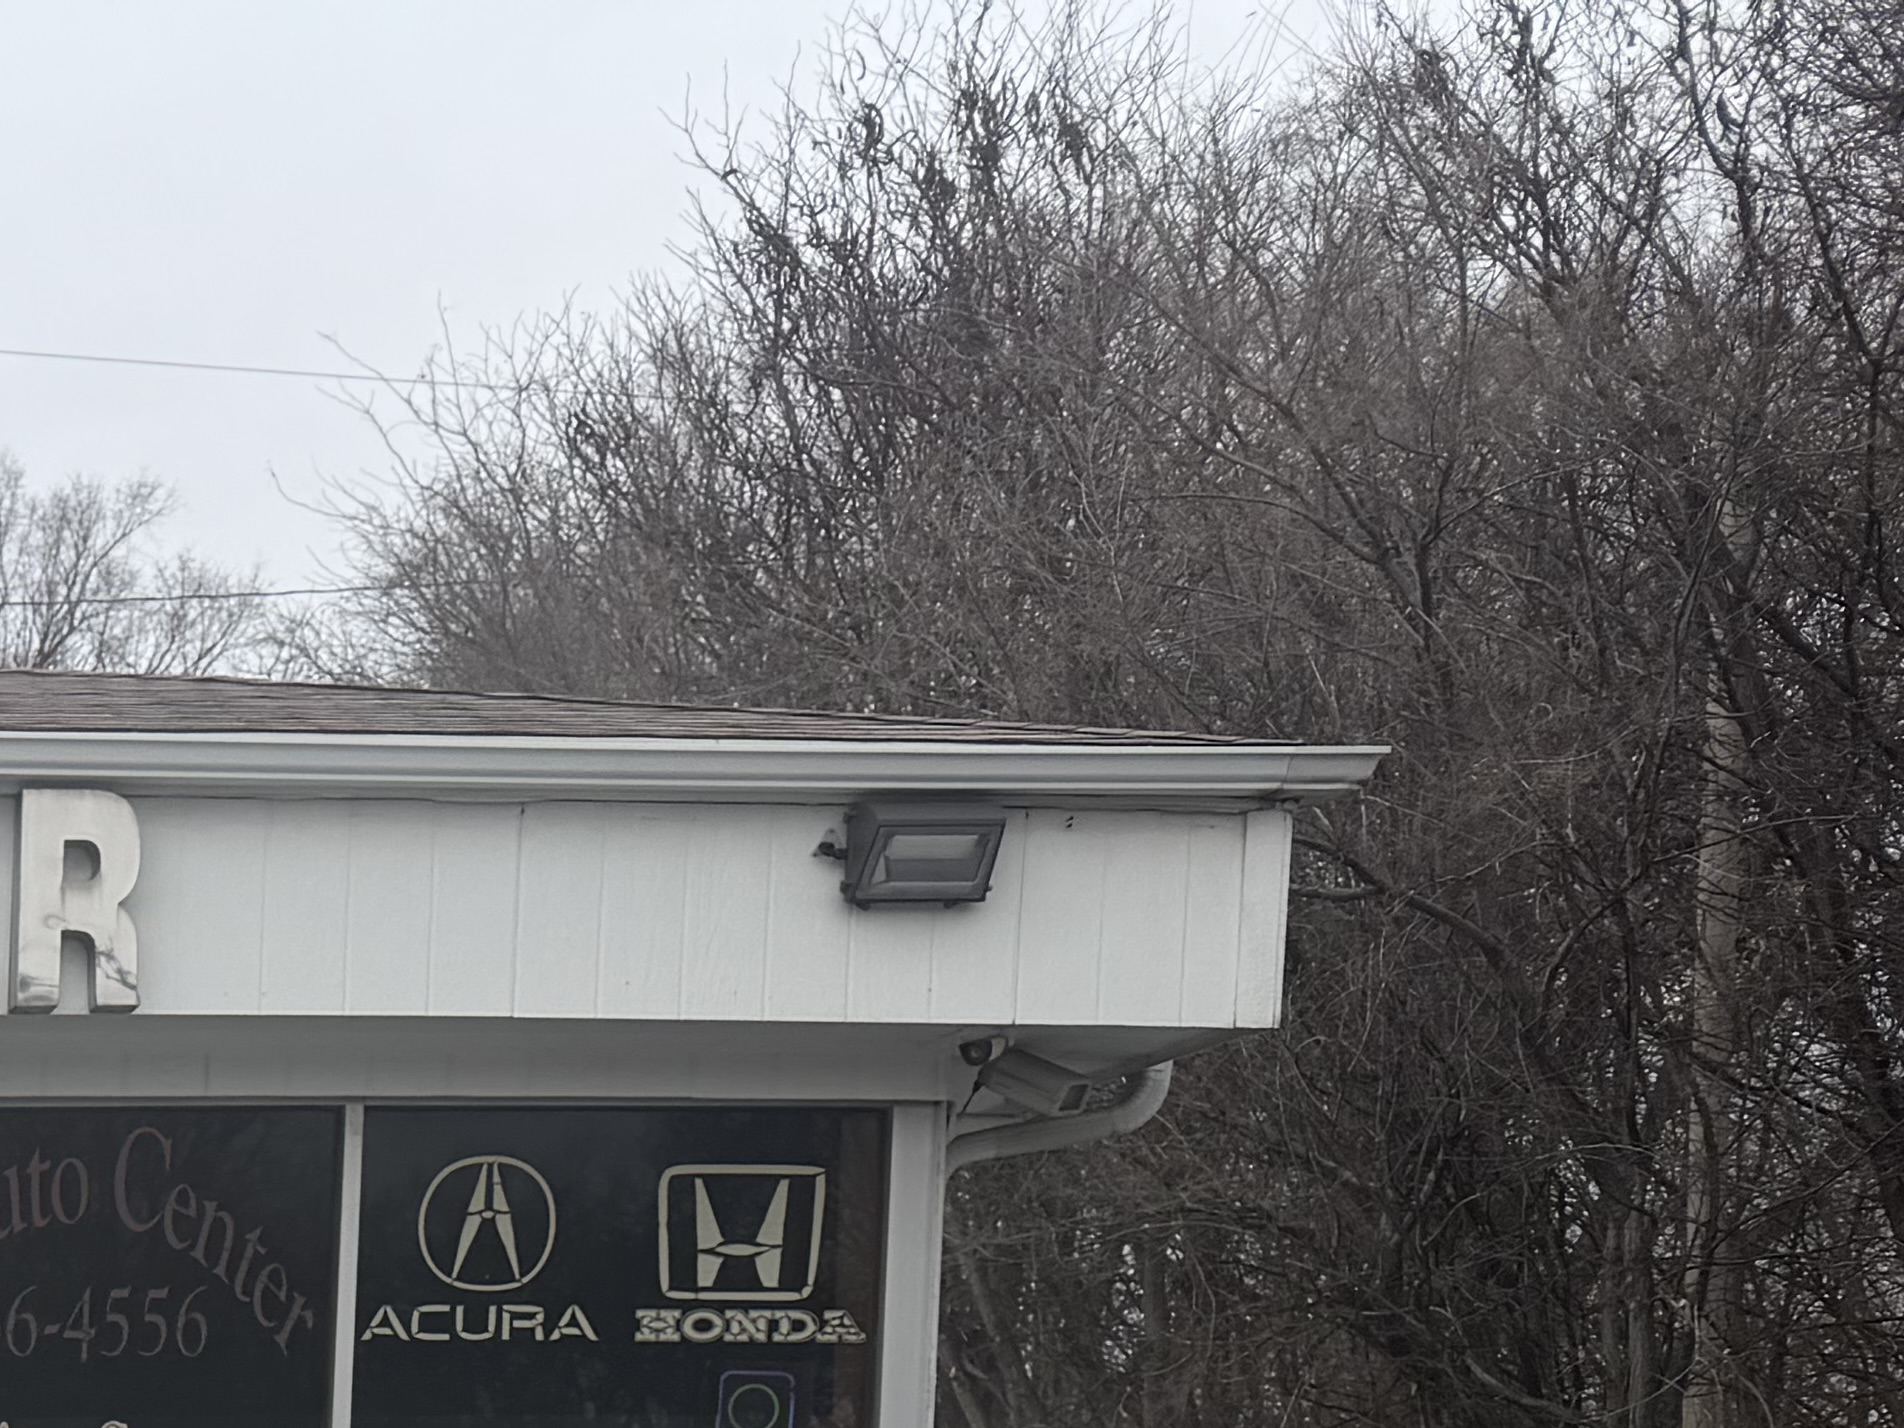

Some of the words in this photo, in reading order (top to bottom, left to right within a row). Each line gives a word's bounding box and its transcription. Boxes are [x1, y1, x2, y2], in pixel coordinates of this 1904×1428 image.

[113, 1126, 314, 1358] Center
[360, 1304, 599, 1341] ACURA
[634, 1309, 866, 1343] HONDA
